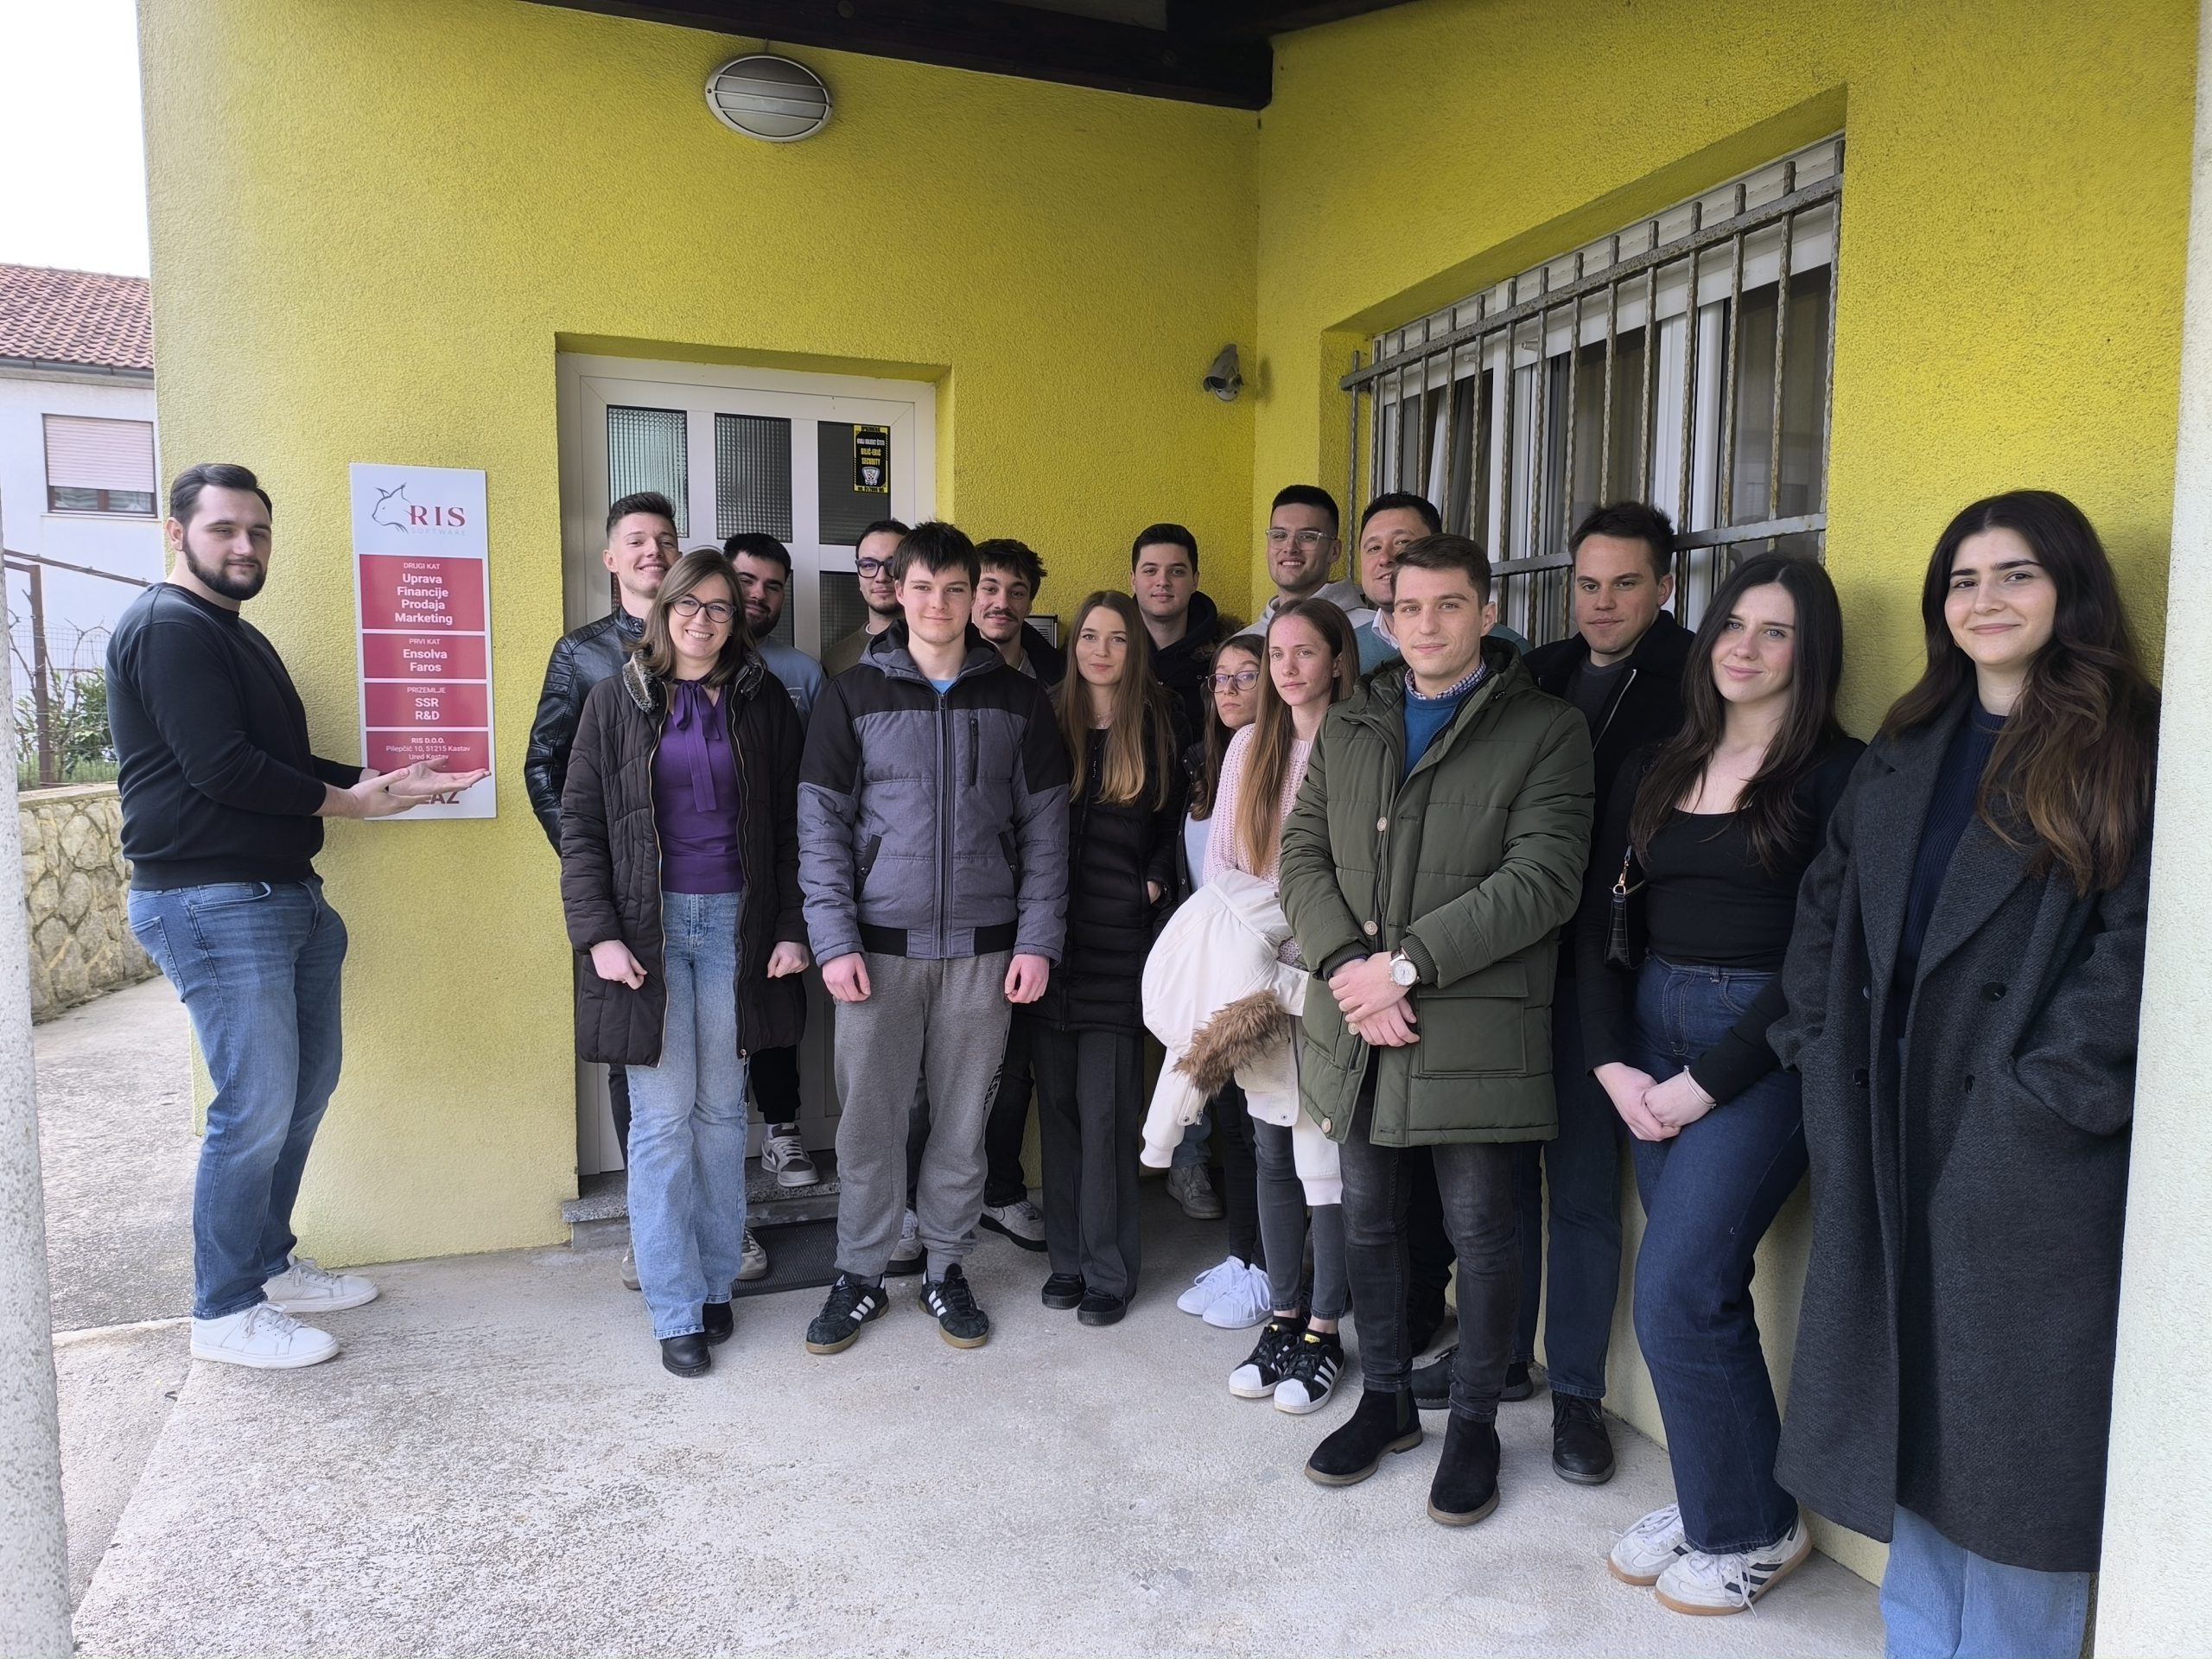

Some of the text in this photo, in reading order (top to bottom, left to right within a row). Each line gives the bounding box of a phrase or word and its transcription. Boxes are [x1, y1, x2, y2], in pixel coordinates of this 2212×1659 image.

[861, 457, 880, 466] SECURITY
[410, 505, 466, 527] RIS
[411, 527, 466, 536] SOFTWARE
[402, 573, 442, 585] Uprava
[397, 586, 449, 599] Financije
[401, 599, 445, 612] Prodaja
[394, 613, 453, 626] Marketing
[403, 648, 448, 659] Ensolva
[410, 662, 442, 671] Faros
[415, 697, 439, 708] SSR
[415, 710, 440, 721] R&D
[421, 791, 460, 804] AZ
